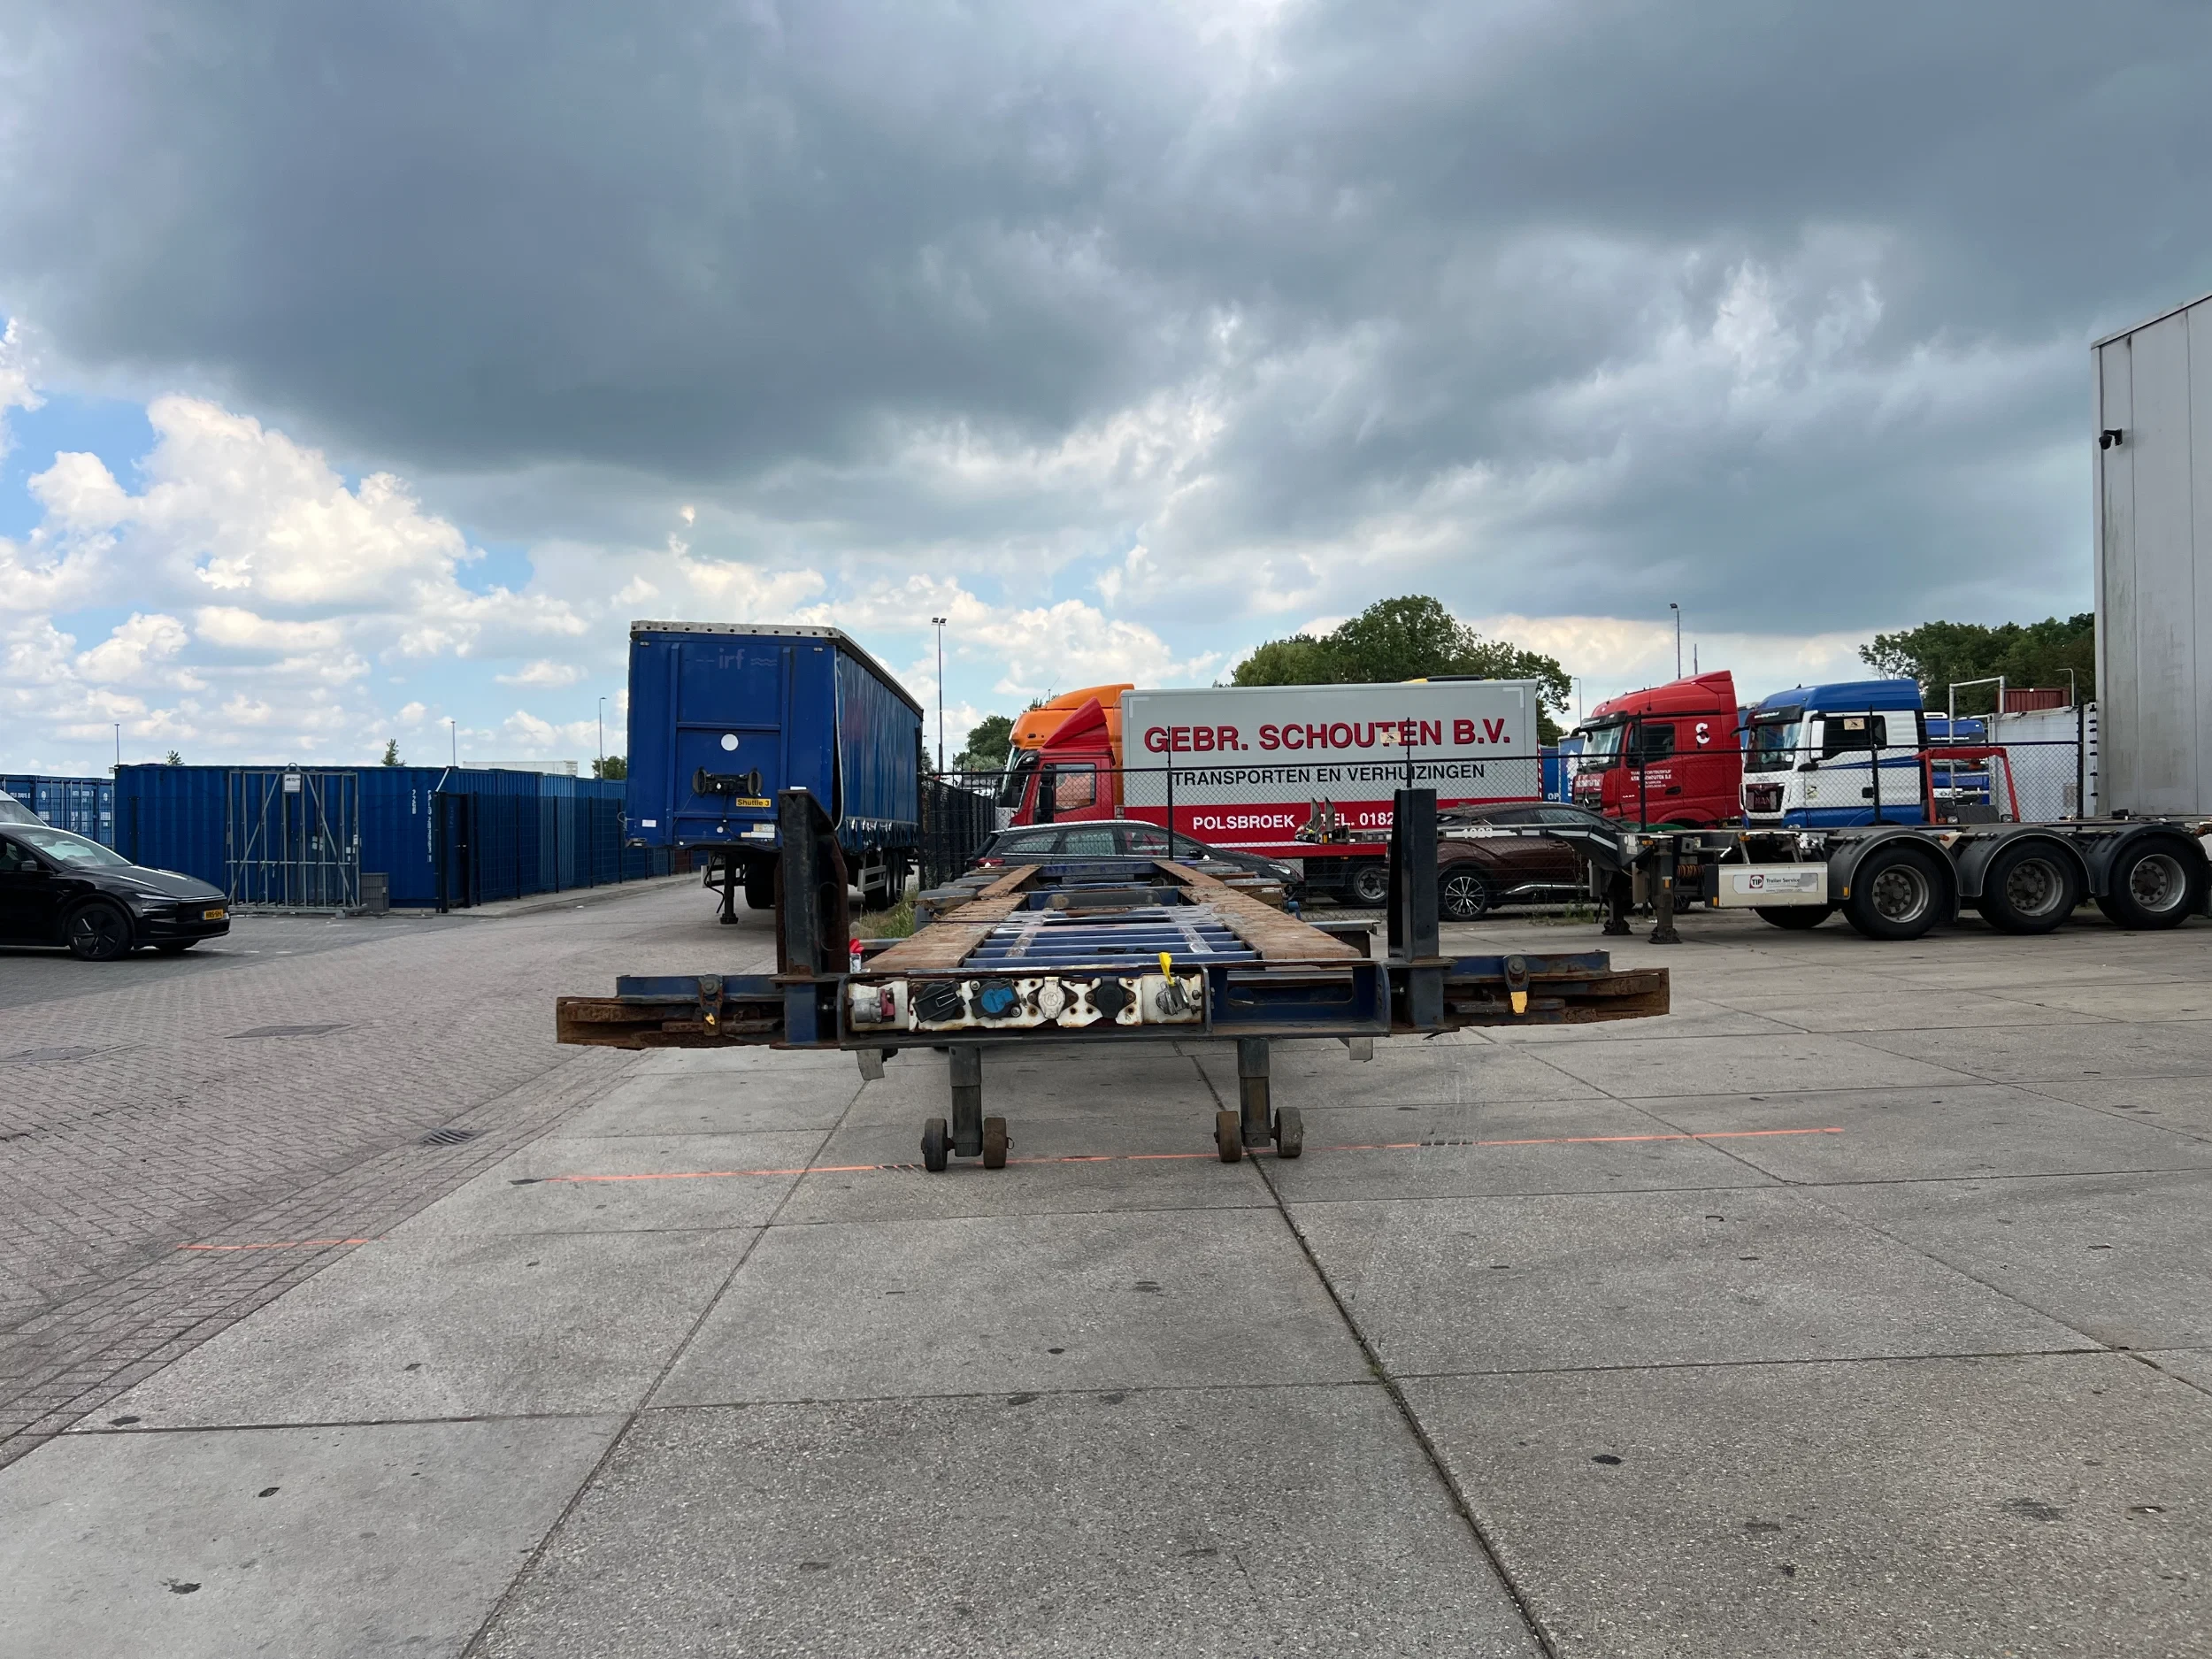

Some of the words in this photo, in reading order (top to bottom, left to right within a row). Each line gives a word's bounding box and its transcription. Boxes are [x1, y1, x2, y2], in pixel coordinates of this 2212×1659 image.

[1144, 726, 1248, 753] GEBR.
[1259, 720, 1441, 750] SCHOUTEN
[1454, 718, 1510, 744] B.V.
[1172, 769, 1310, 786] TRANSPORTEN
[1317, 768, 1340, 782] EN
[1348, 764, 1485, 781] VERHUIZINGEN
[1193, 814, 1295, 830] POLSBROEK
[1359, 811, 1394, 826] 0182
